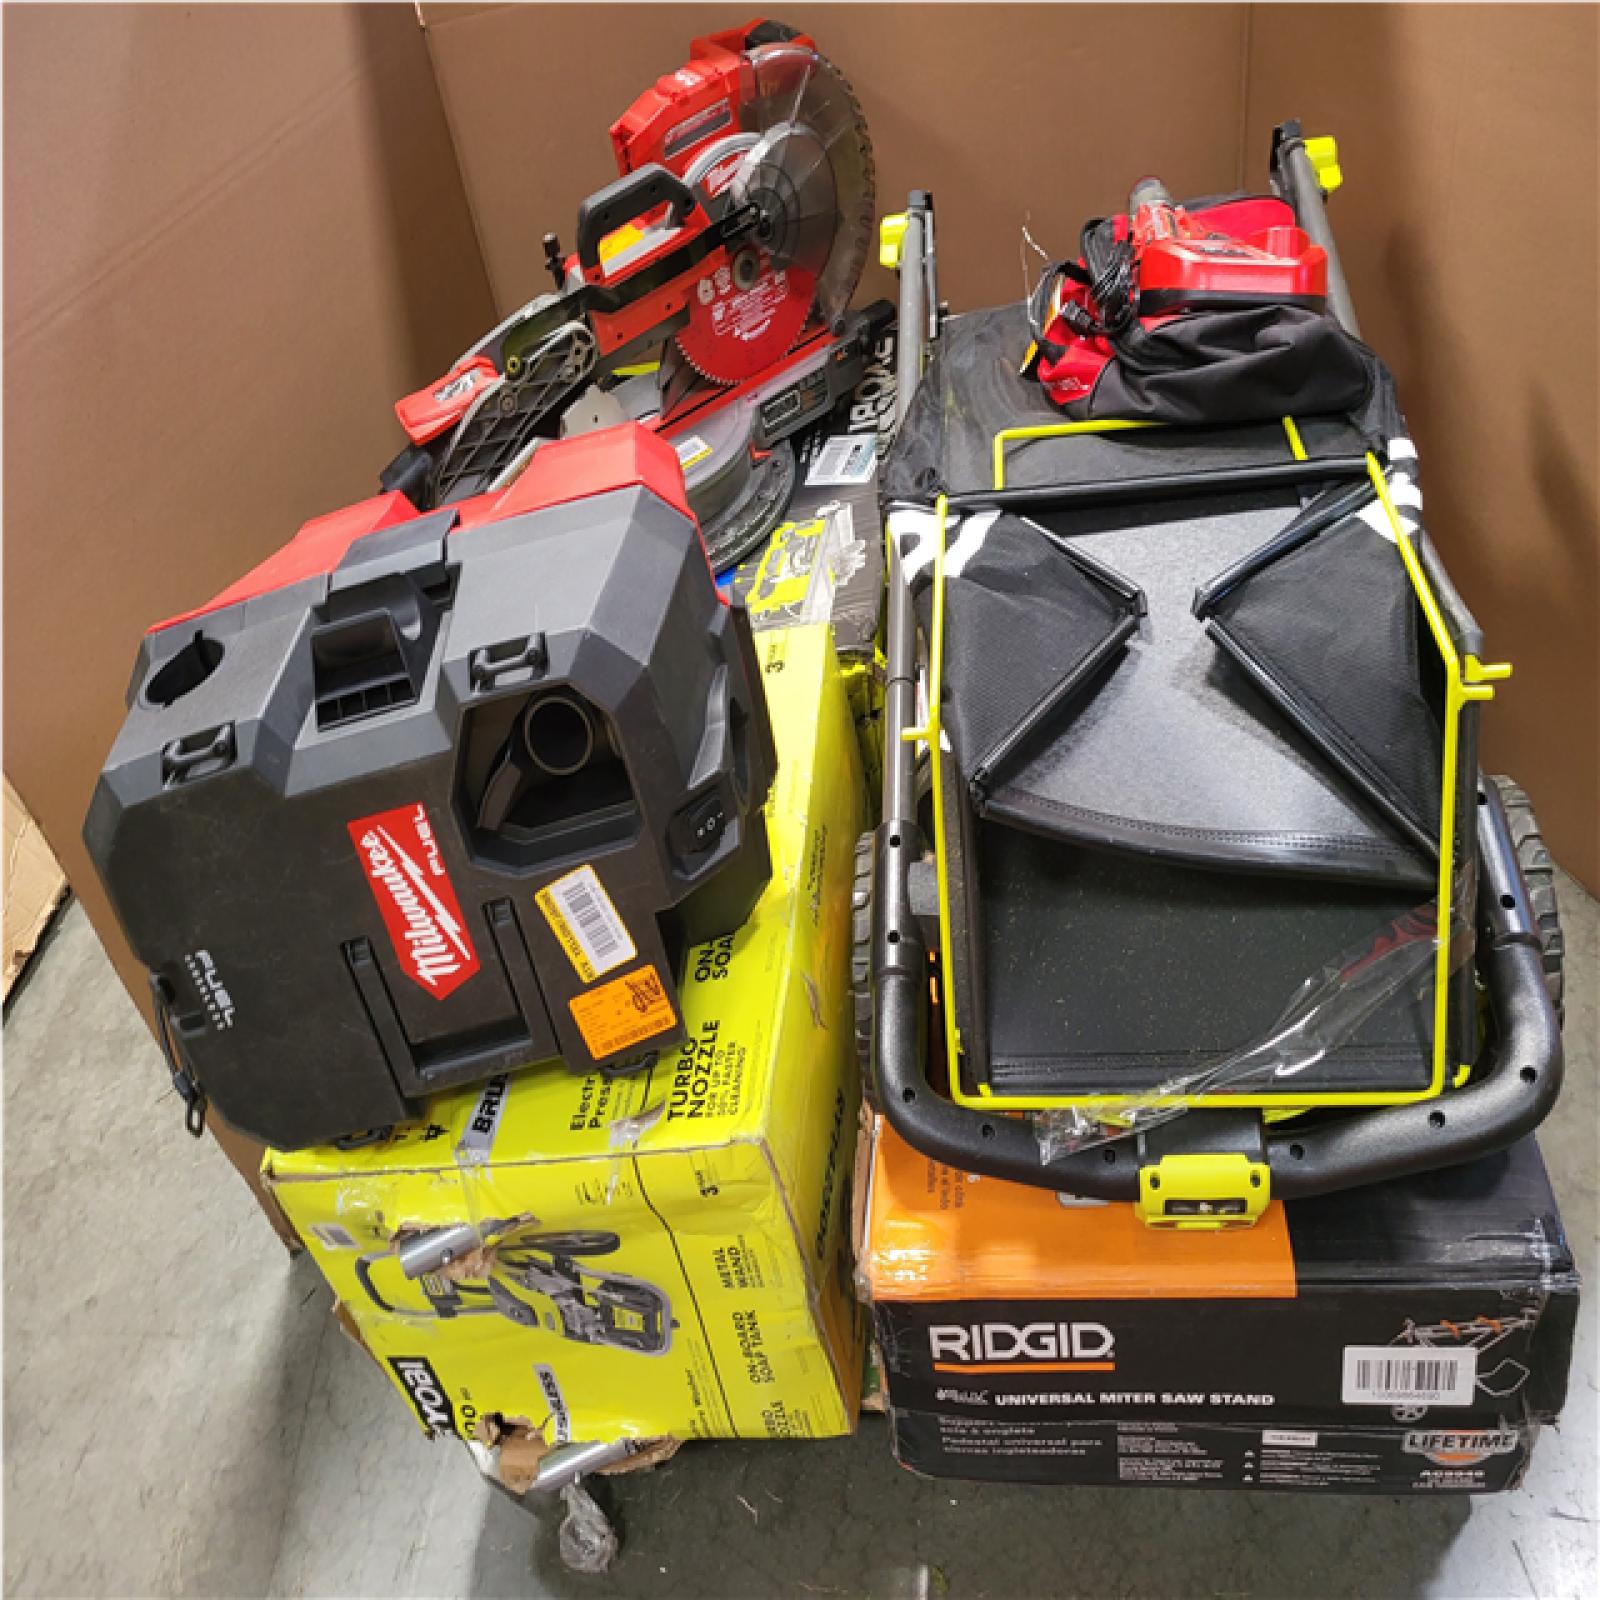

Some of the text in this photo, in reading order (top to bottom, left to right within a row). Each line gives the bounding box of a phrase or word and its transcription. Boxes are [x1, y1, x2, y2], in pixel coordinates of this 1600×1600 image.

[412, 804, 444, 876] FUEL
[361, 829, 461, 987] Milwaukee
[687, 1020, 722, 1119] NOZZLE
[929, 1322, 1115, 1361] RIDGID
[995, 1392, 1096, 1406] UNIVERSAL
[1099, 1391, 1156, 1405] MITER
[1161, 1392, 1205, 1405] SAW
[1210, 1394, 1275, 1407] STAND
[1407, 1434, 1516, 1449] LIFETIME
